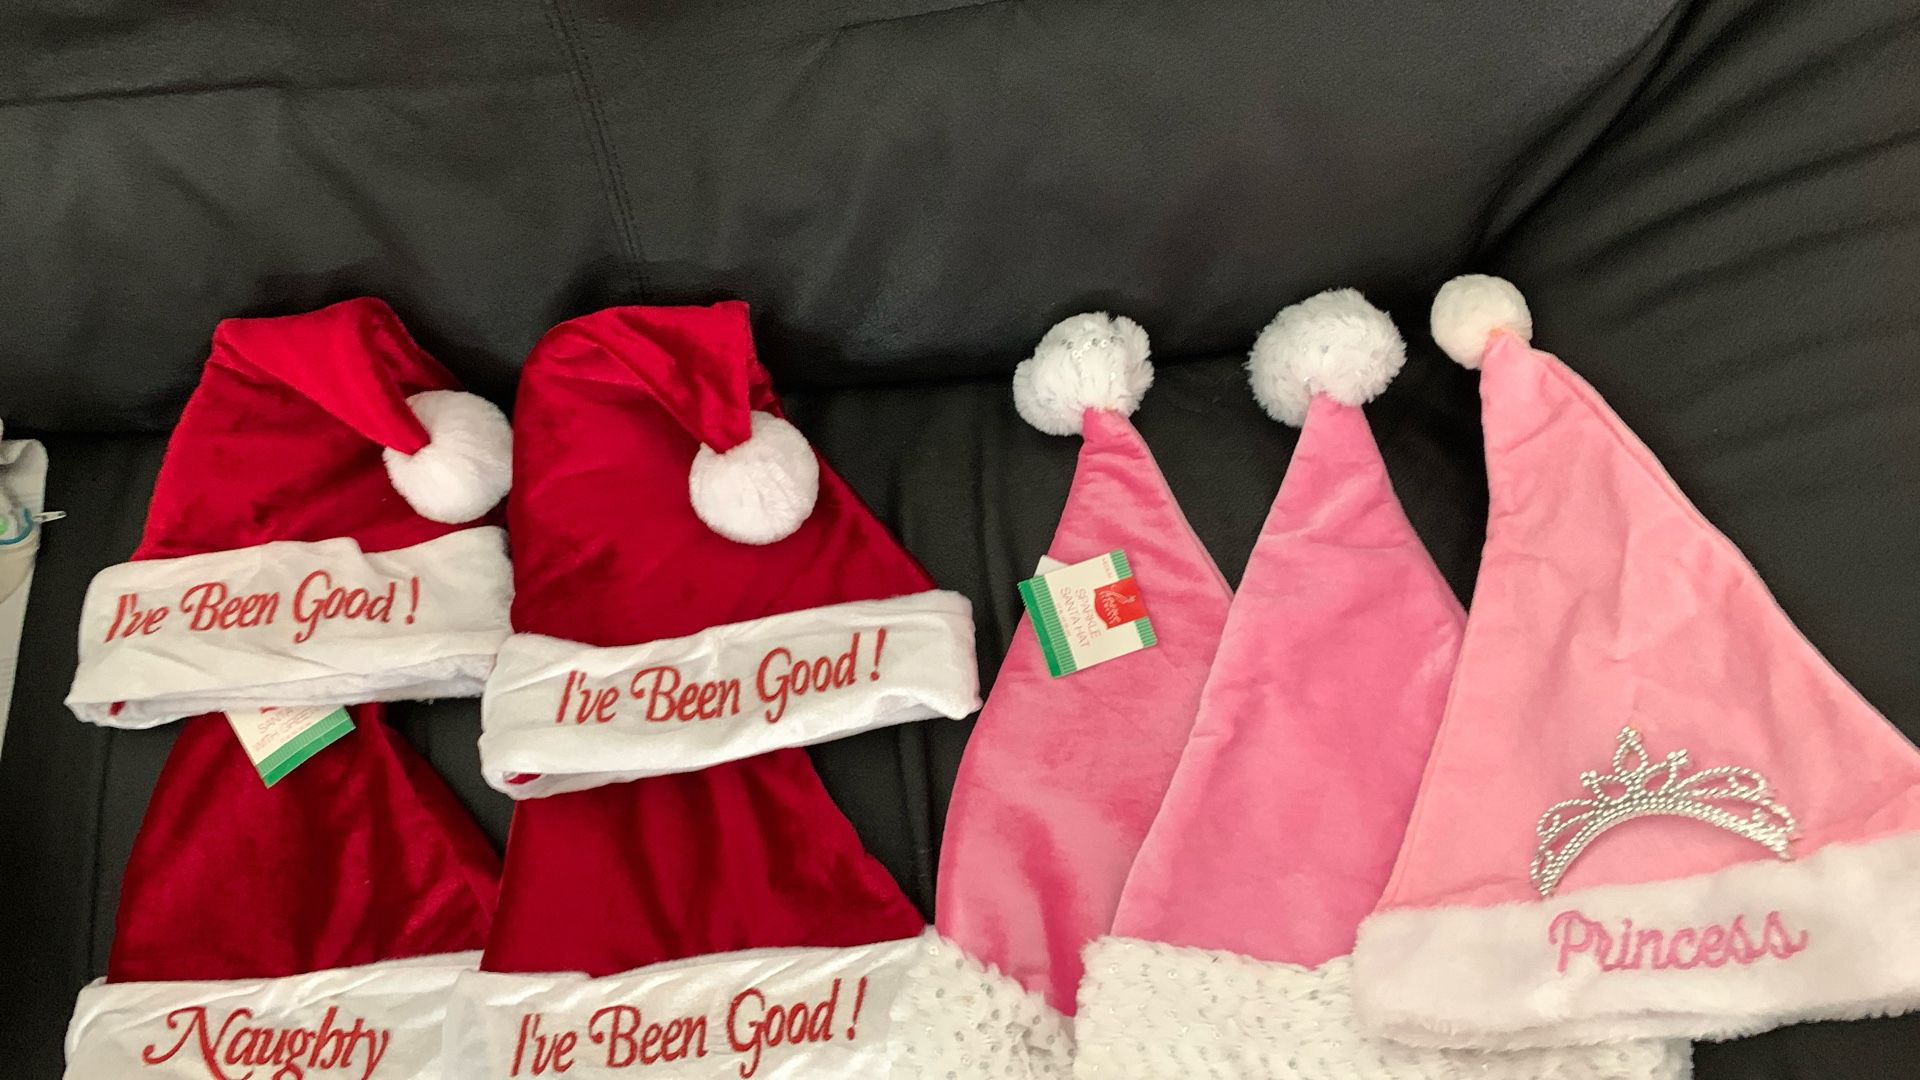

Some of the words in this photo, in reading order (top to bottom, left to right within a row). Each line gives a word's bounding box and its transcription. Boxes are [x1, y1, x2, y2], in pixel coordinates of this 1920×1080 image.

[104, 591, 170, 643] I've
[178, 580, 281, 633] Been
[1060, 586, 1081, 626] SANTA
[1075, 625, 1090, 649] HAT
[1075, 588, 1102, 639] SPARKLE
[555, 669, 621, 726] I've
[628, 665, 742, 725] Been
[1548, 909, 1810, 975] Princess
[140, 1004, 391, 1080] Naughty
[509, 1012, 579, 1079] I've
[587, 1003, 710, 1070] Been
